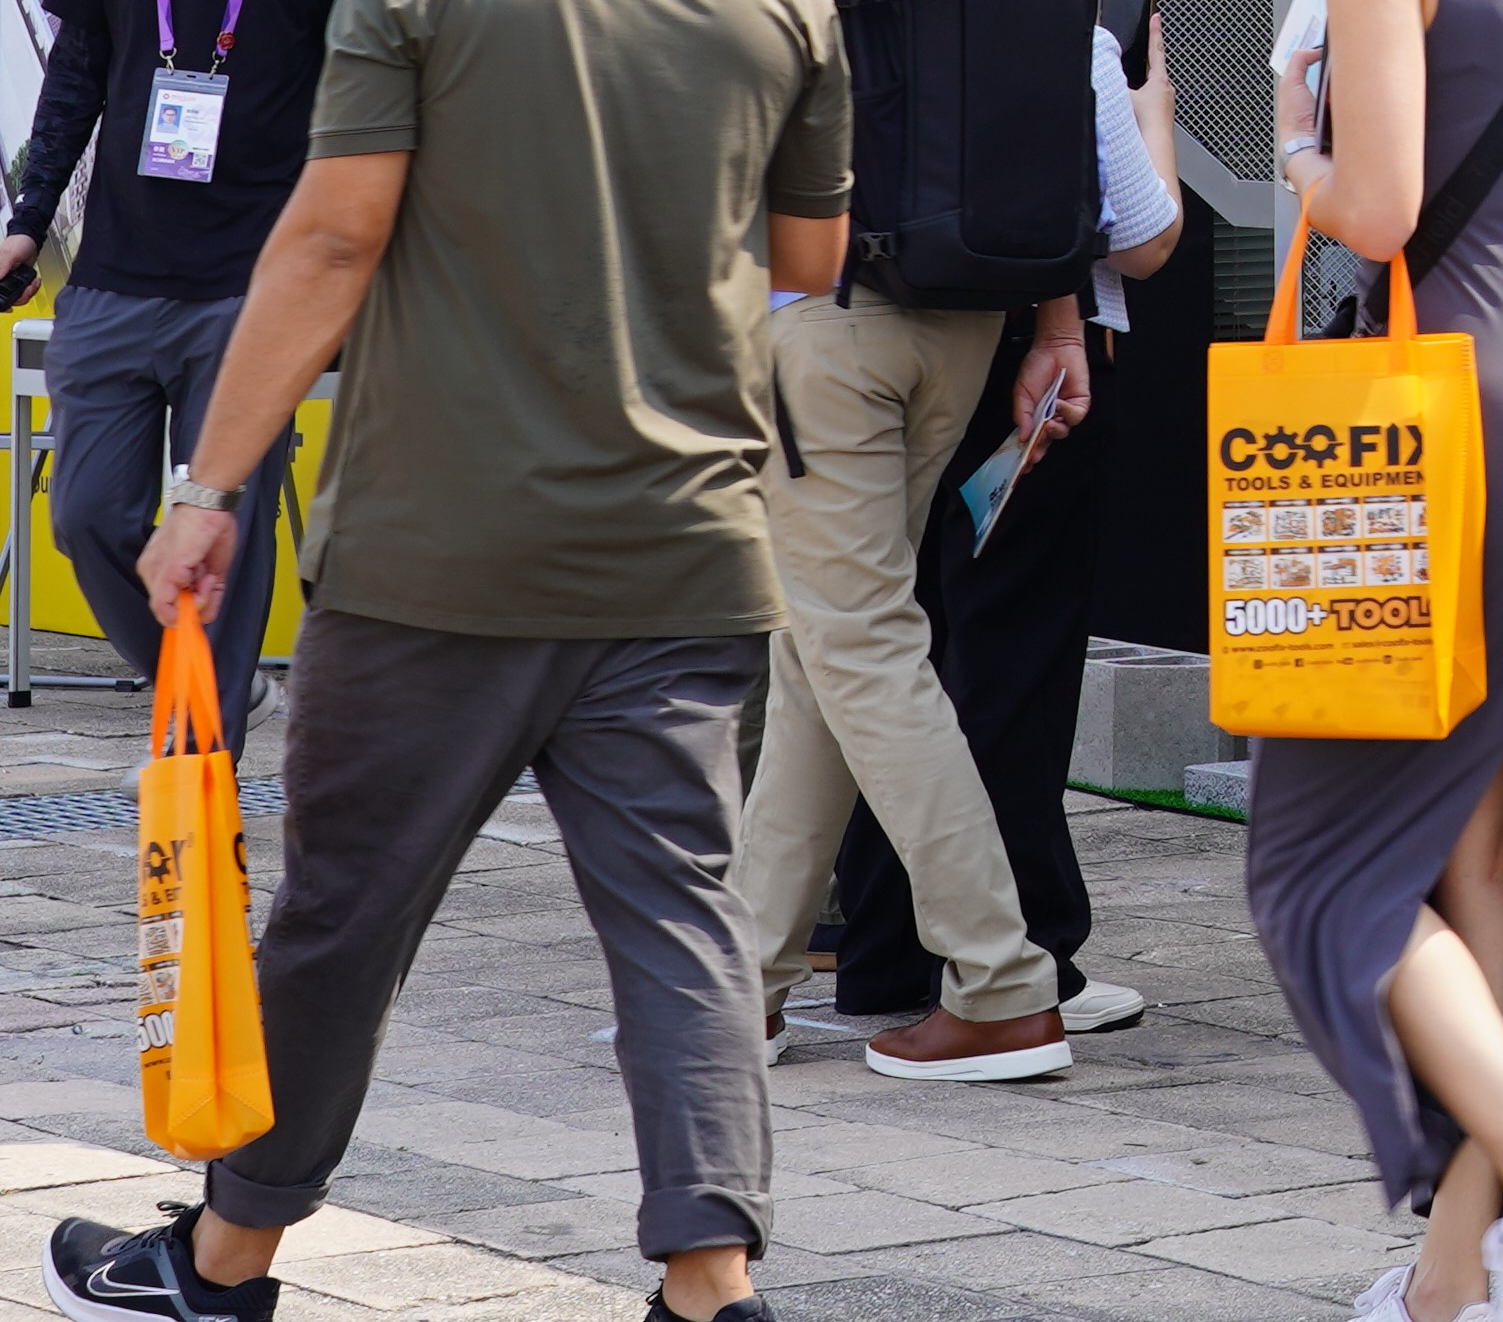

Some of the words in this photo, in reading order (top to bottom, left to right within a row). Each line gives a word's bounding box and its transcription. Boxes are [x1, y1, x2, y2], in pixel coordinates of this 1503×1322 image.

[1225, 476, 1291, 491] TOOLS
[1298, 475, 1313, 490] &
[1224, 596, 1329, 637] 5000+
[1330, 595, 1431, 631] TOOL
